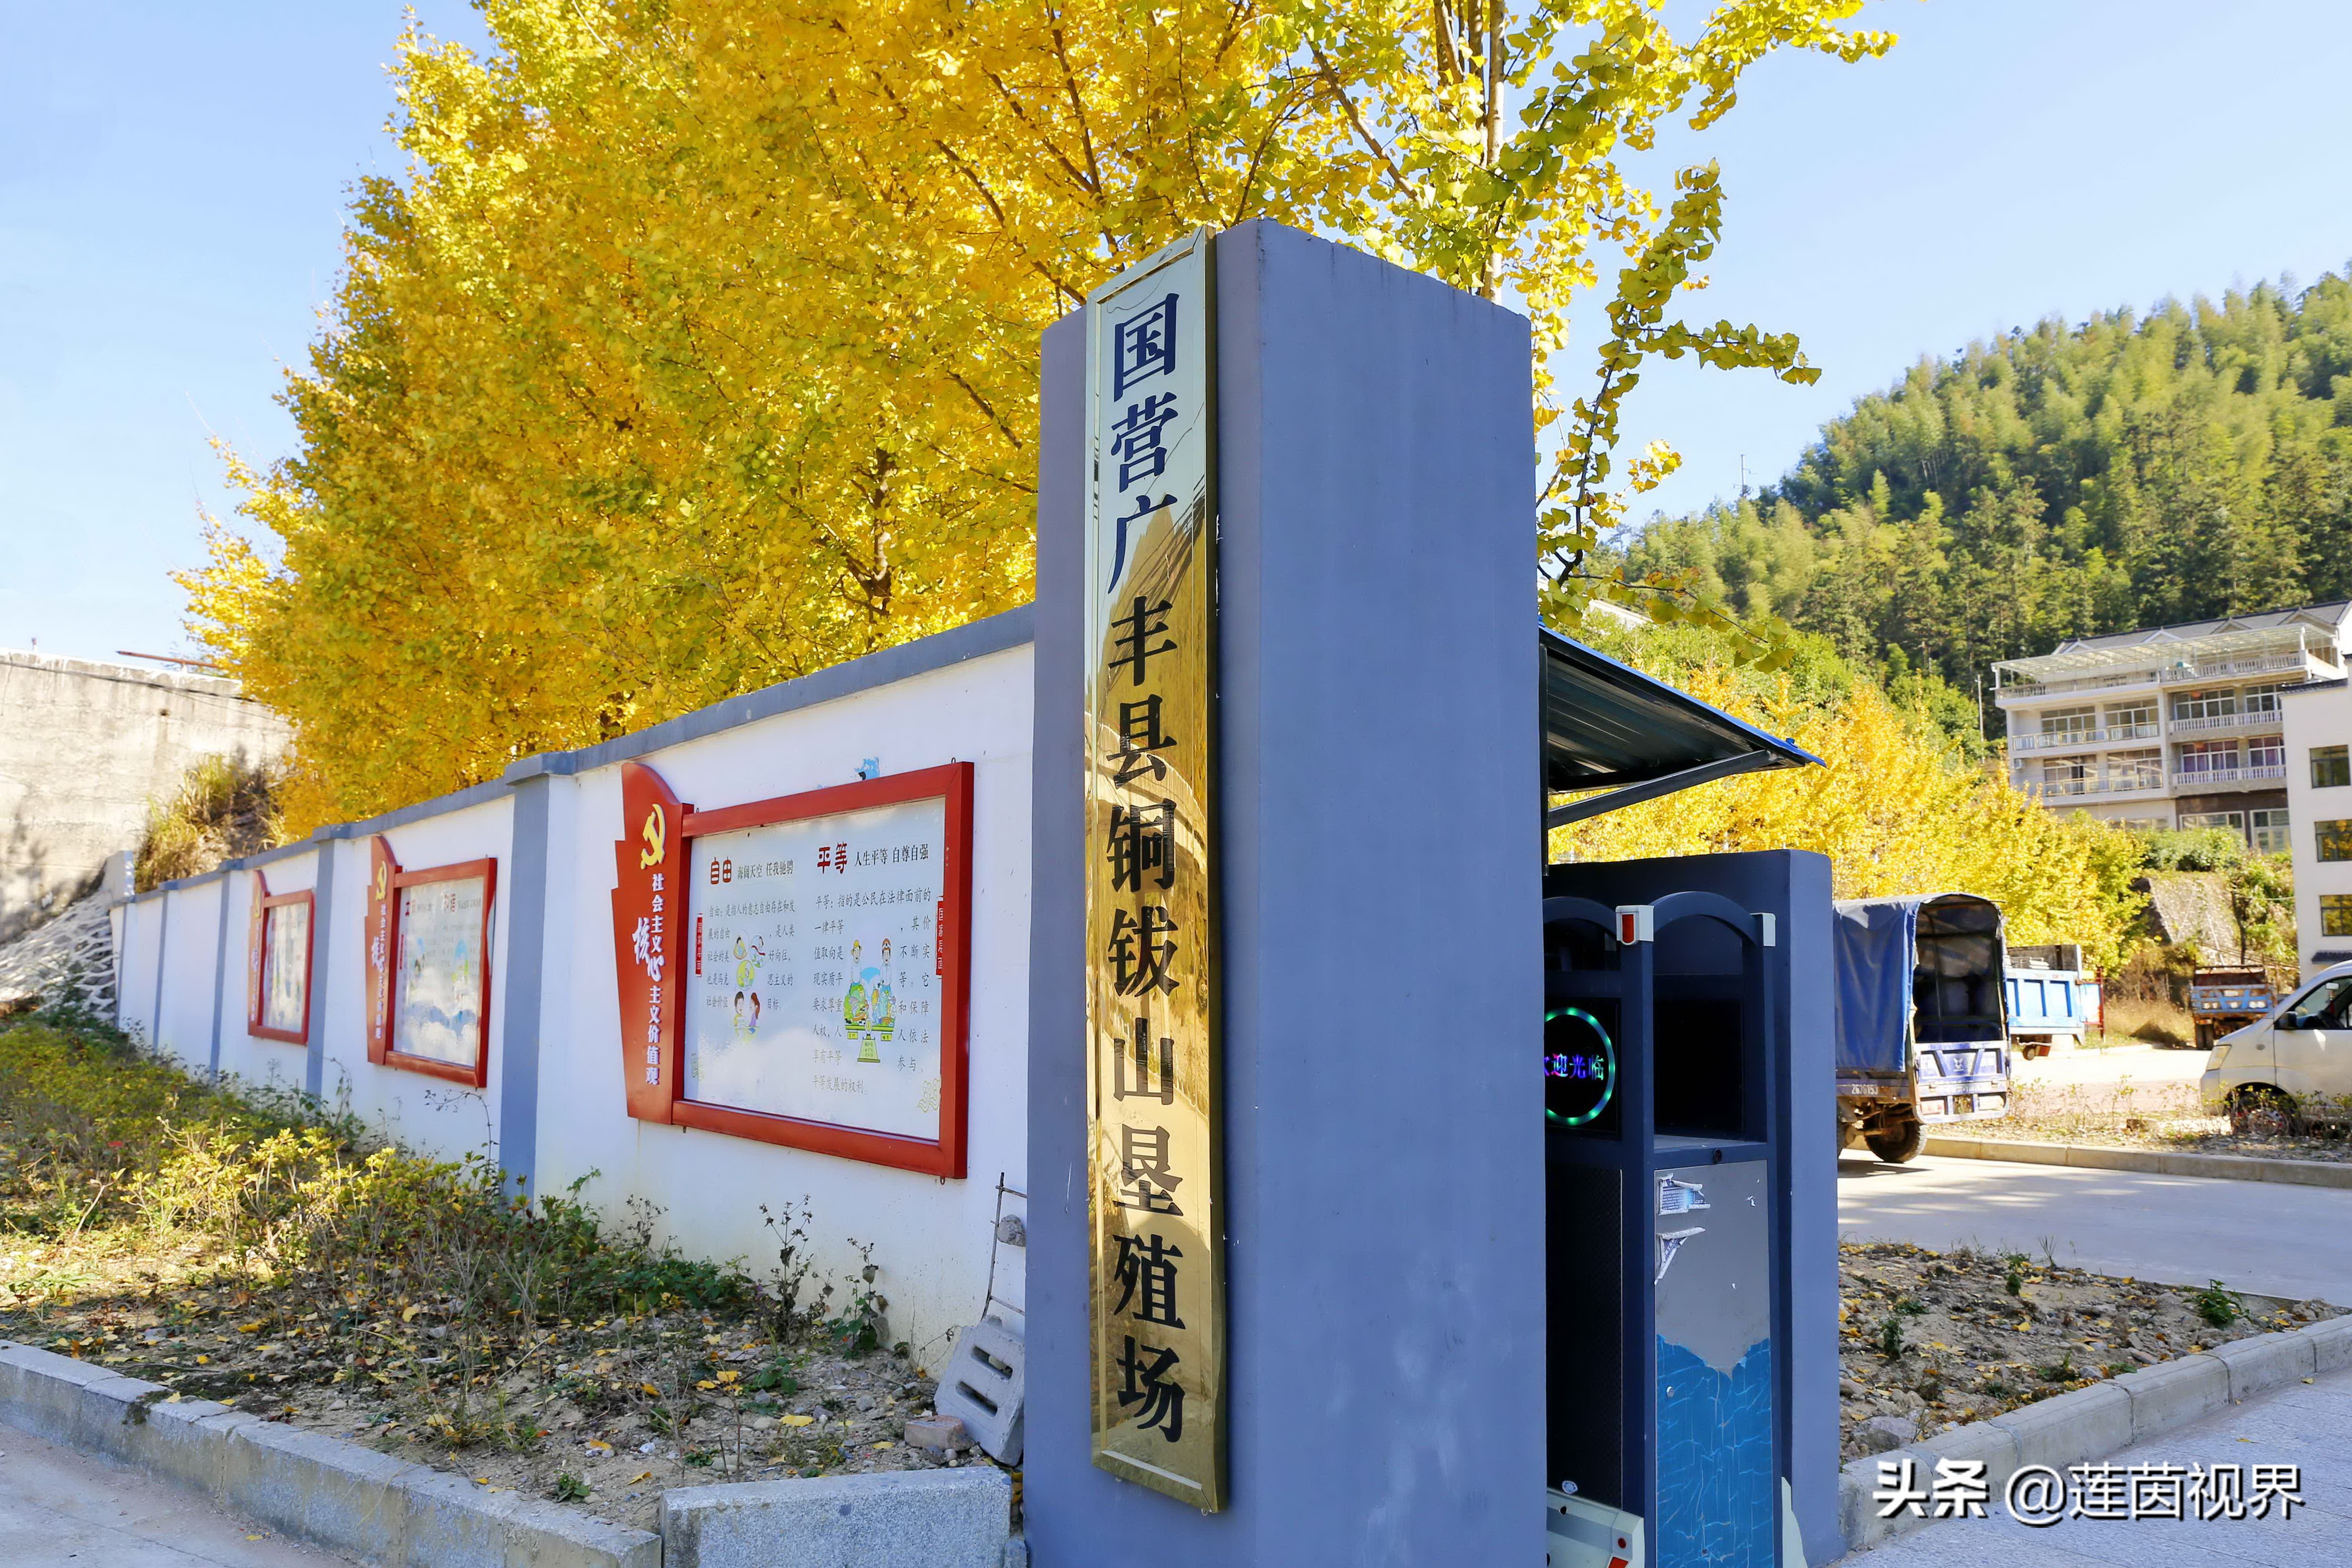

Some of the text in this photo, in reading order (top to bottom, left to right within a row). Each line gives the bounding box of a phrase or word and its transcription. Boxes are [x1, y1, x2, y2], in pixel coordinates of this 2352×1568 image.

[710, 856, 732, 885] 自由
[737, 864, 762, 880] 海阔天空
[818, 841, 929, 874] 平等 人生平等 自尊自强
[1107, 293, 1185, 1442] 国营广丰县铜钹山垦殖场
